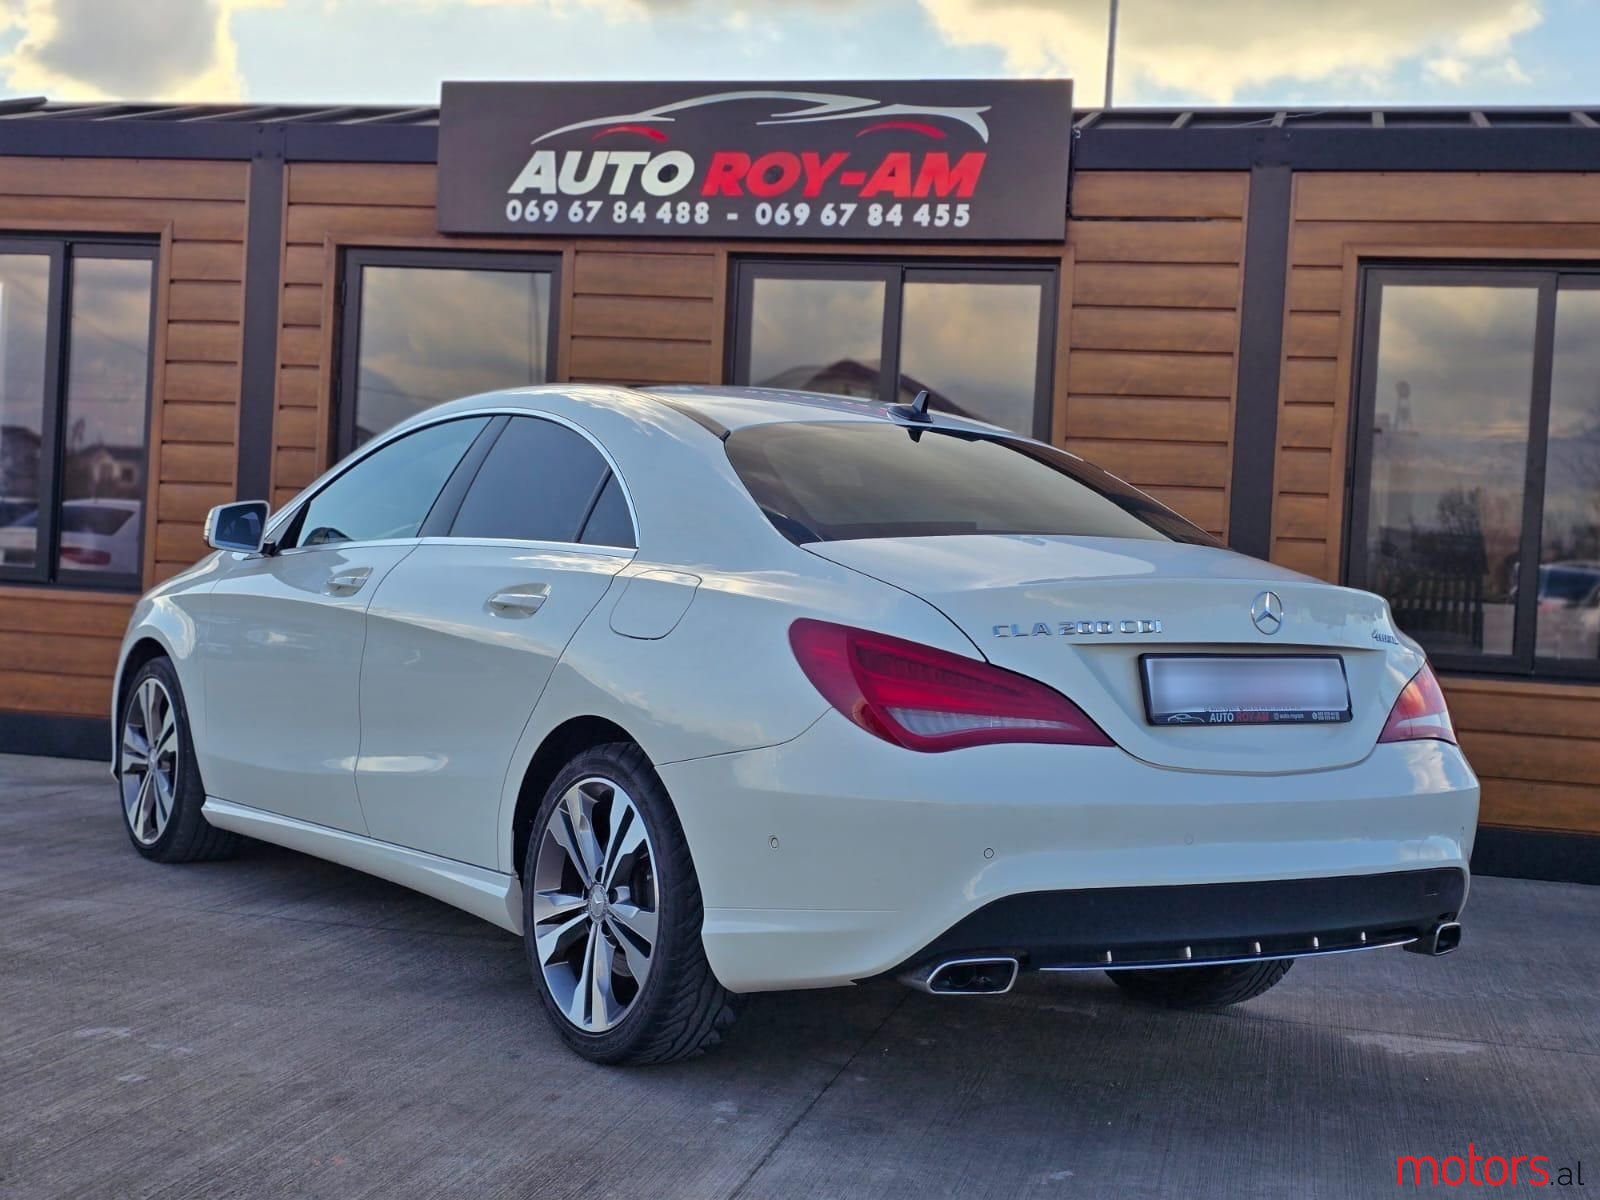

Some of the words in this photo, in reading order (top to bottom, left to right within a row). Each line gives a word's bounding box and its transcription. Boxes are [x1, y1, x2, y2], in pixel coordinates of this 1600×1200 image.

[507, 150, 695, 196] AUTO
[702, 151, 987, 197] ROY-AM
[506, 199, 559, 222] 069
[568, 200, 603, 223] 67
[612, 201, 647, 224] 84
[655, 201, 710, 224] 488
[755, 202, 810, 226] 069
[820, 203, 857, 226] 67
[867, 203, 903, 227] 84
[912, 204, 970, 227] 455
[992, 622, 1052, 638] CLA
[1059, 620, 1114, 635] 200
[1120, 619, 1162, 634] CDI
[1210, 712, 1234, 722] AUTO
